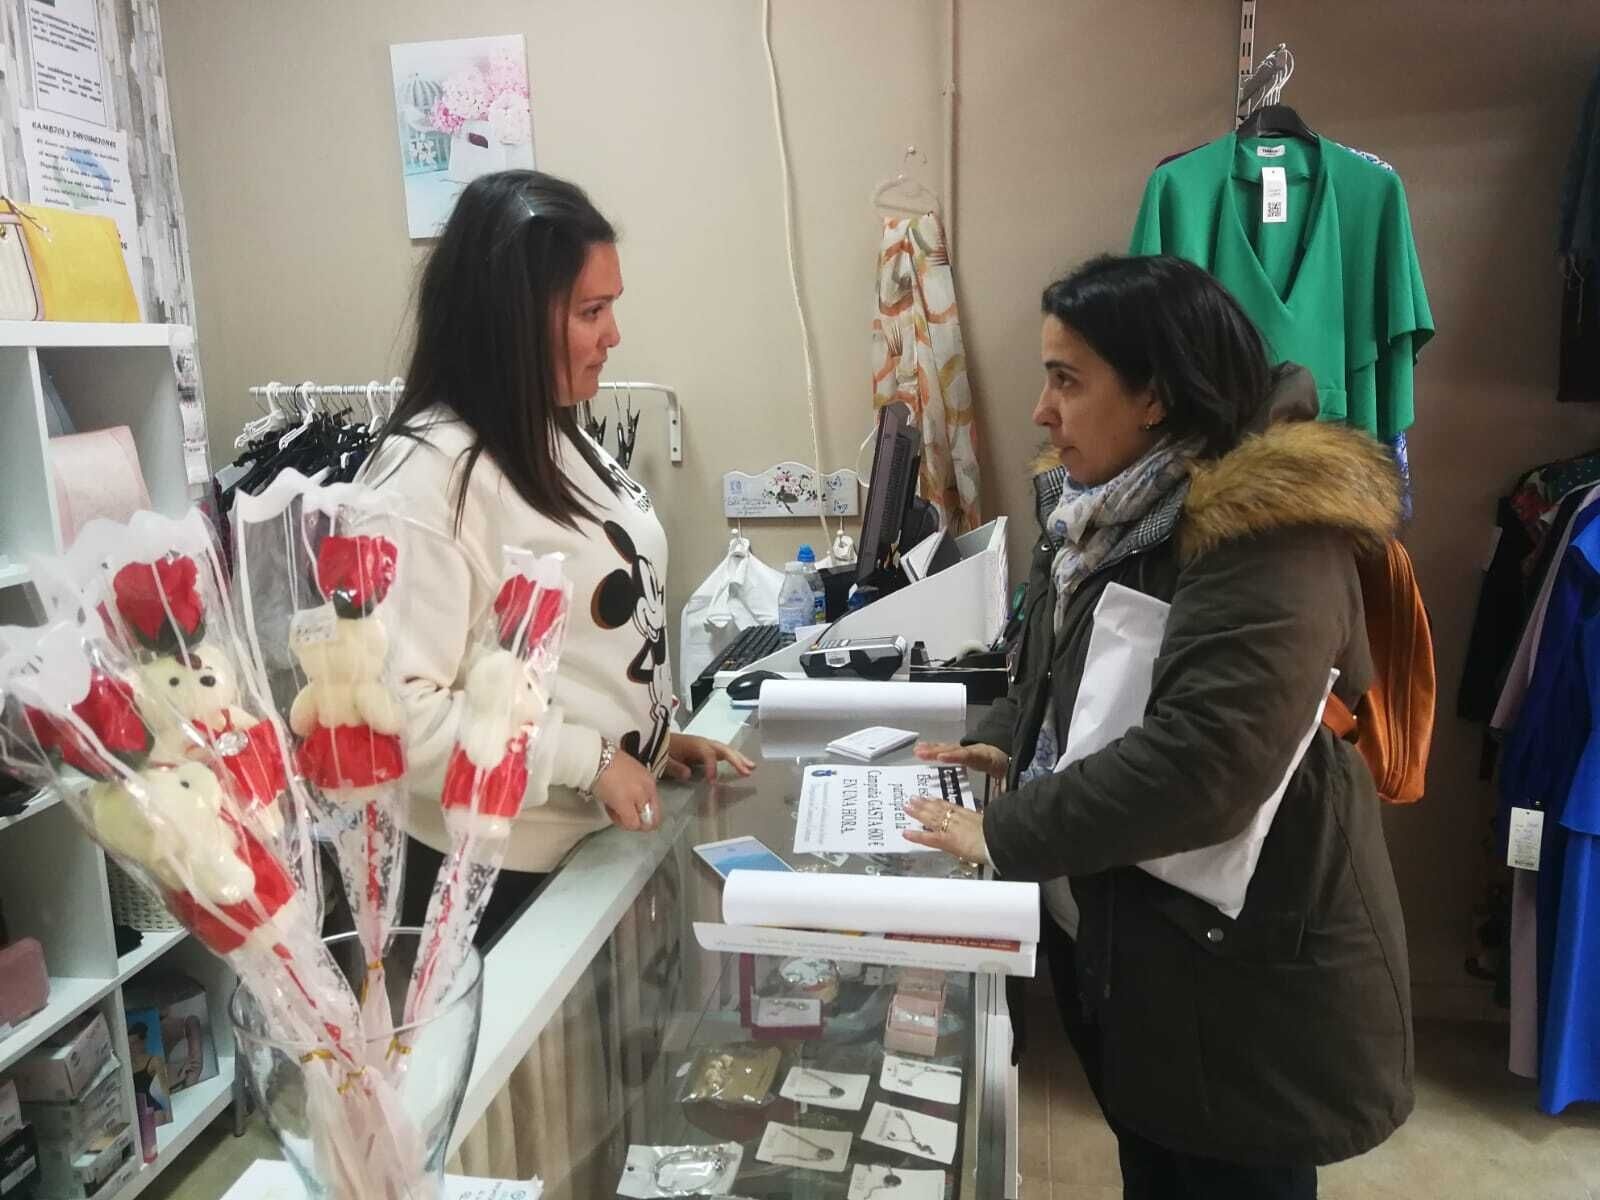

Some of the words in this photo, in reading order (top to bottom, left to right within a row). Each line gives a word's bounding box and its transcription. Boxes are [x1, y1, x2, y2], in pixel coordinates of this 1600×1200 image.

[842, 778, 857, 789] EN
[864, 769, 882, 798] Campaña
[916, 774, 930, 786] Este
[841, 790, 857, 807] UNA
[867, 799, 884, 827] GASTA
[894, 812, 905, 820] en
[867, 828, 884, 841] 600
